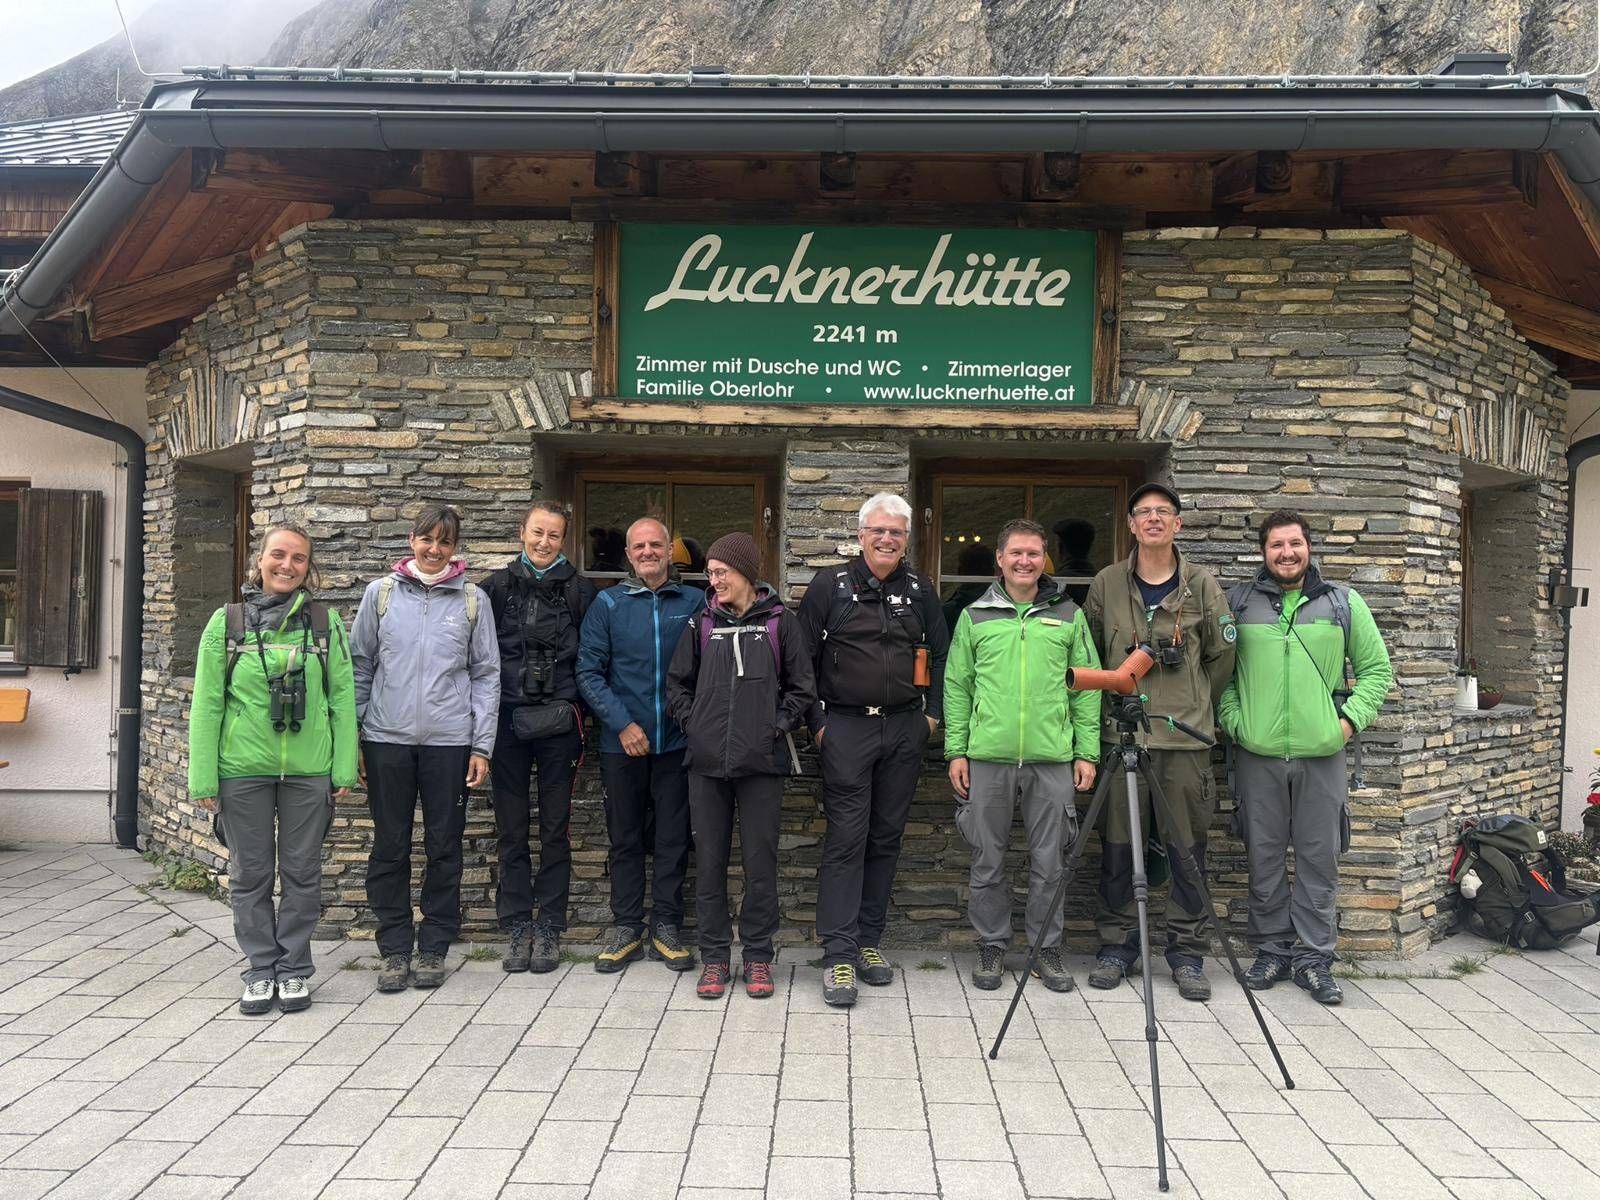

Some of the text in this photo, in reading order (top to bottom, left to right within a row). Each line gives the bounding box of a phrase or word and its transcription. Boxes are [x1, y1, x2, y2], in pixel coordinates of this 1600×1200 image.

[644, 231, 1071, 312] Lucknerhütte
[812, 324, 898, 344] 2241 m
[636, 356, 1072, 382] Zimmer mit Dusche und WC Zimmerlager
[636, 378, 1076, 401] Familie Oberlohr www.lucknerhuette.at
